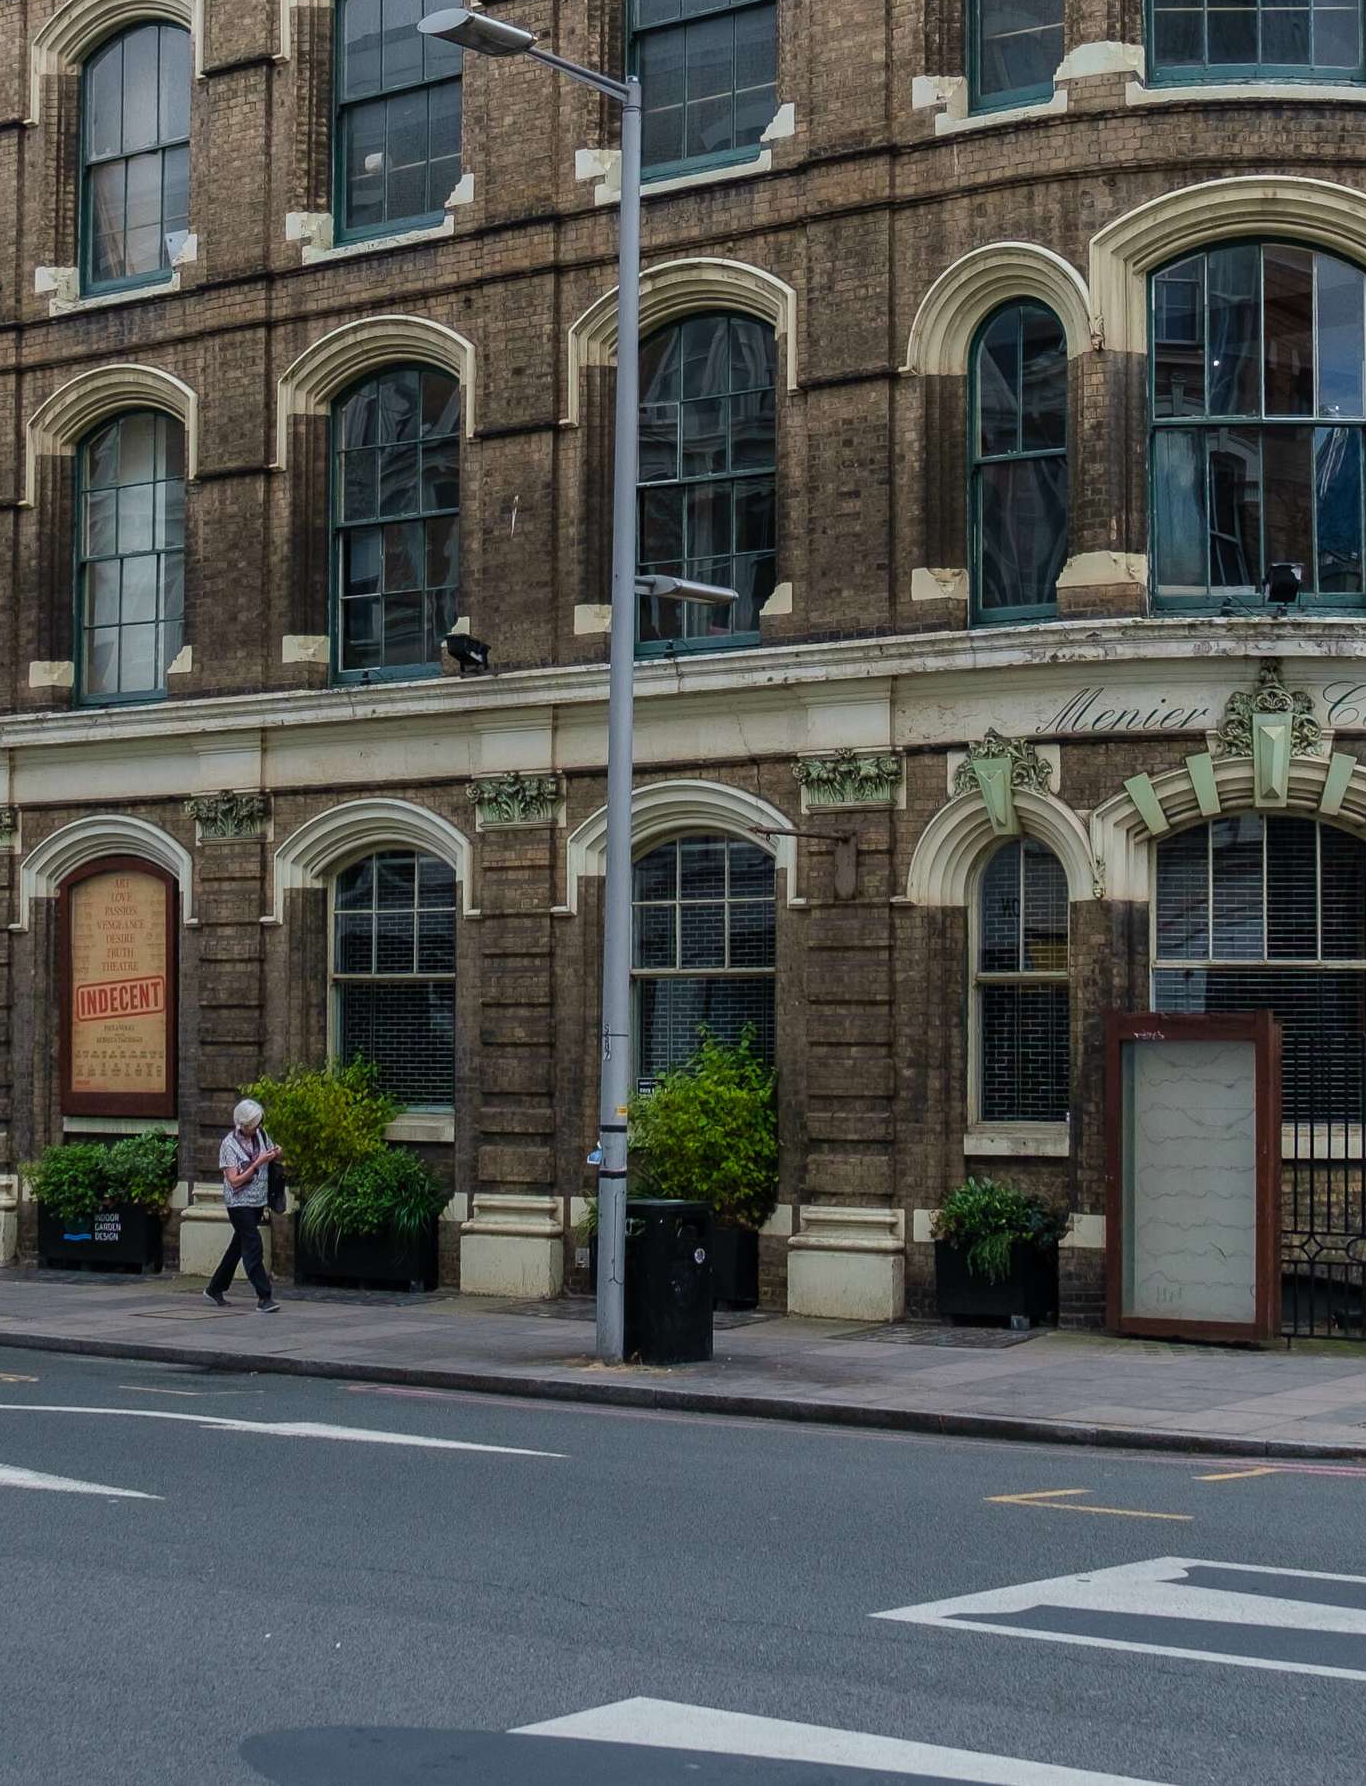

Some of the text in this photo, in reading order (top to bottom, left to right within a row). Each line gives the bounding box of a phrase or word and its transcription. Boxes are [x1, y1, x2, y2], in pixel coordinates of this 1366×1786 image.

[1035, 686, 1209, 734] Menier
[115, 878, 130, 889] ART
[111, 892, 132, 903] LOVE
[105, 906, 138, 916] PASSION
[97, 919, 145, 930] VENGEANCE
[106, 932, 135, 943] DESIRE
[106, 947, 134, 959] TRUTH
[101, 961, 139, 972] THEATRE
[80, 982, 161, 1017] INDECENT
[94, 1213, 120, 1222] INDOOR
[94, 1223, 122, 1231] GARDEN
[94, 1232, 119, 1241] DESIGN
